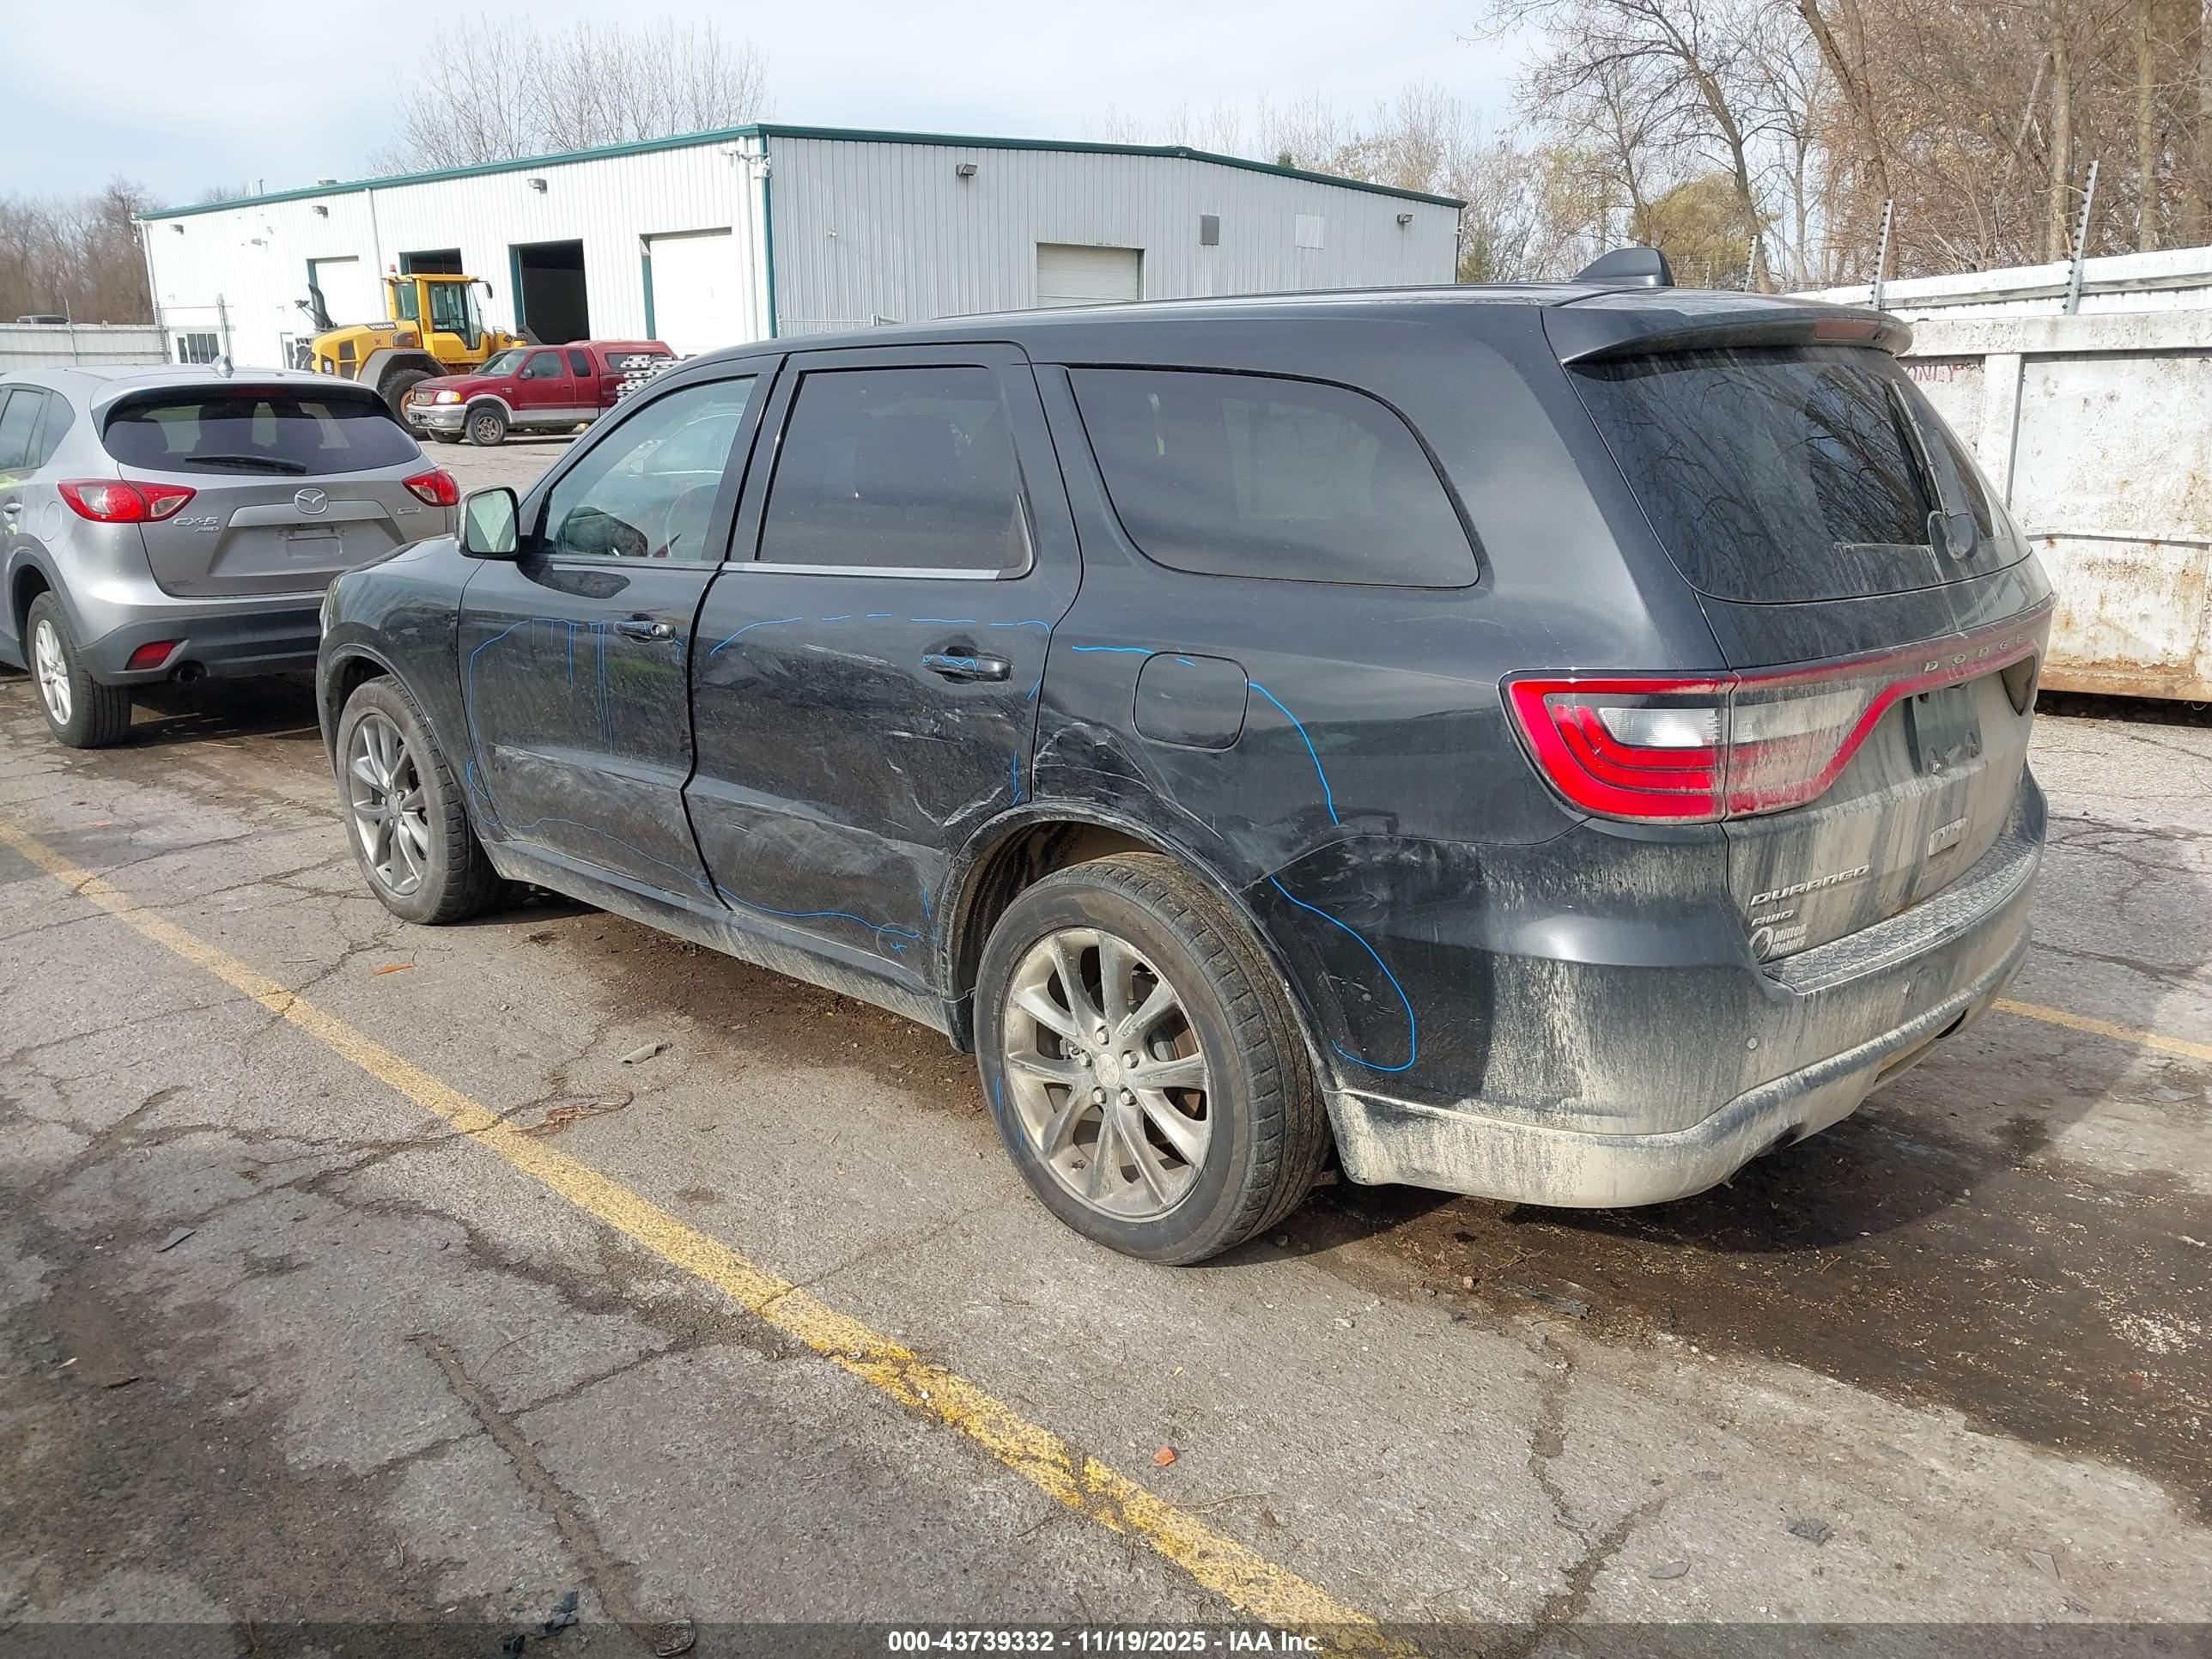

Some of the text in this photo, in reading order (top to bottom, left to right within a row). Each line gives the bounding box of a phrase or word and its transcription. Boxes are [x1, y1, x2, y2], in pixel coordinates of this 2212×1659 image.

[173, 516, 219, 526] CX-5
[1924, 634, 2024, 672] DODGE
[1750, 864, 1870, 907] DURANGO
[1751, 908, 1795, 927] AWD
[1773, 923, 1808, 944] Mitten
[1769, 936, 1807, 957] Motors
